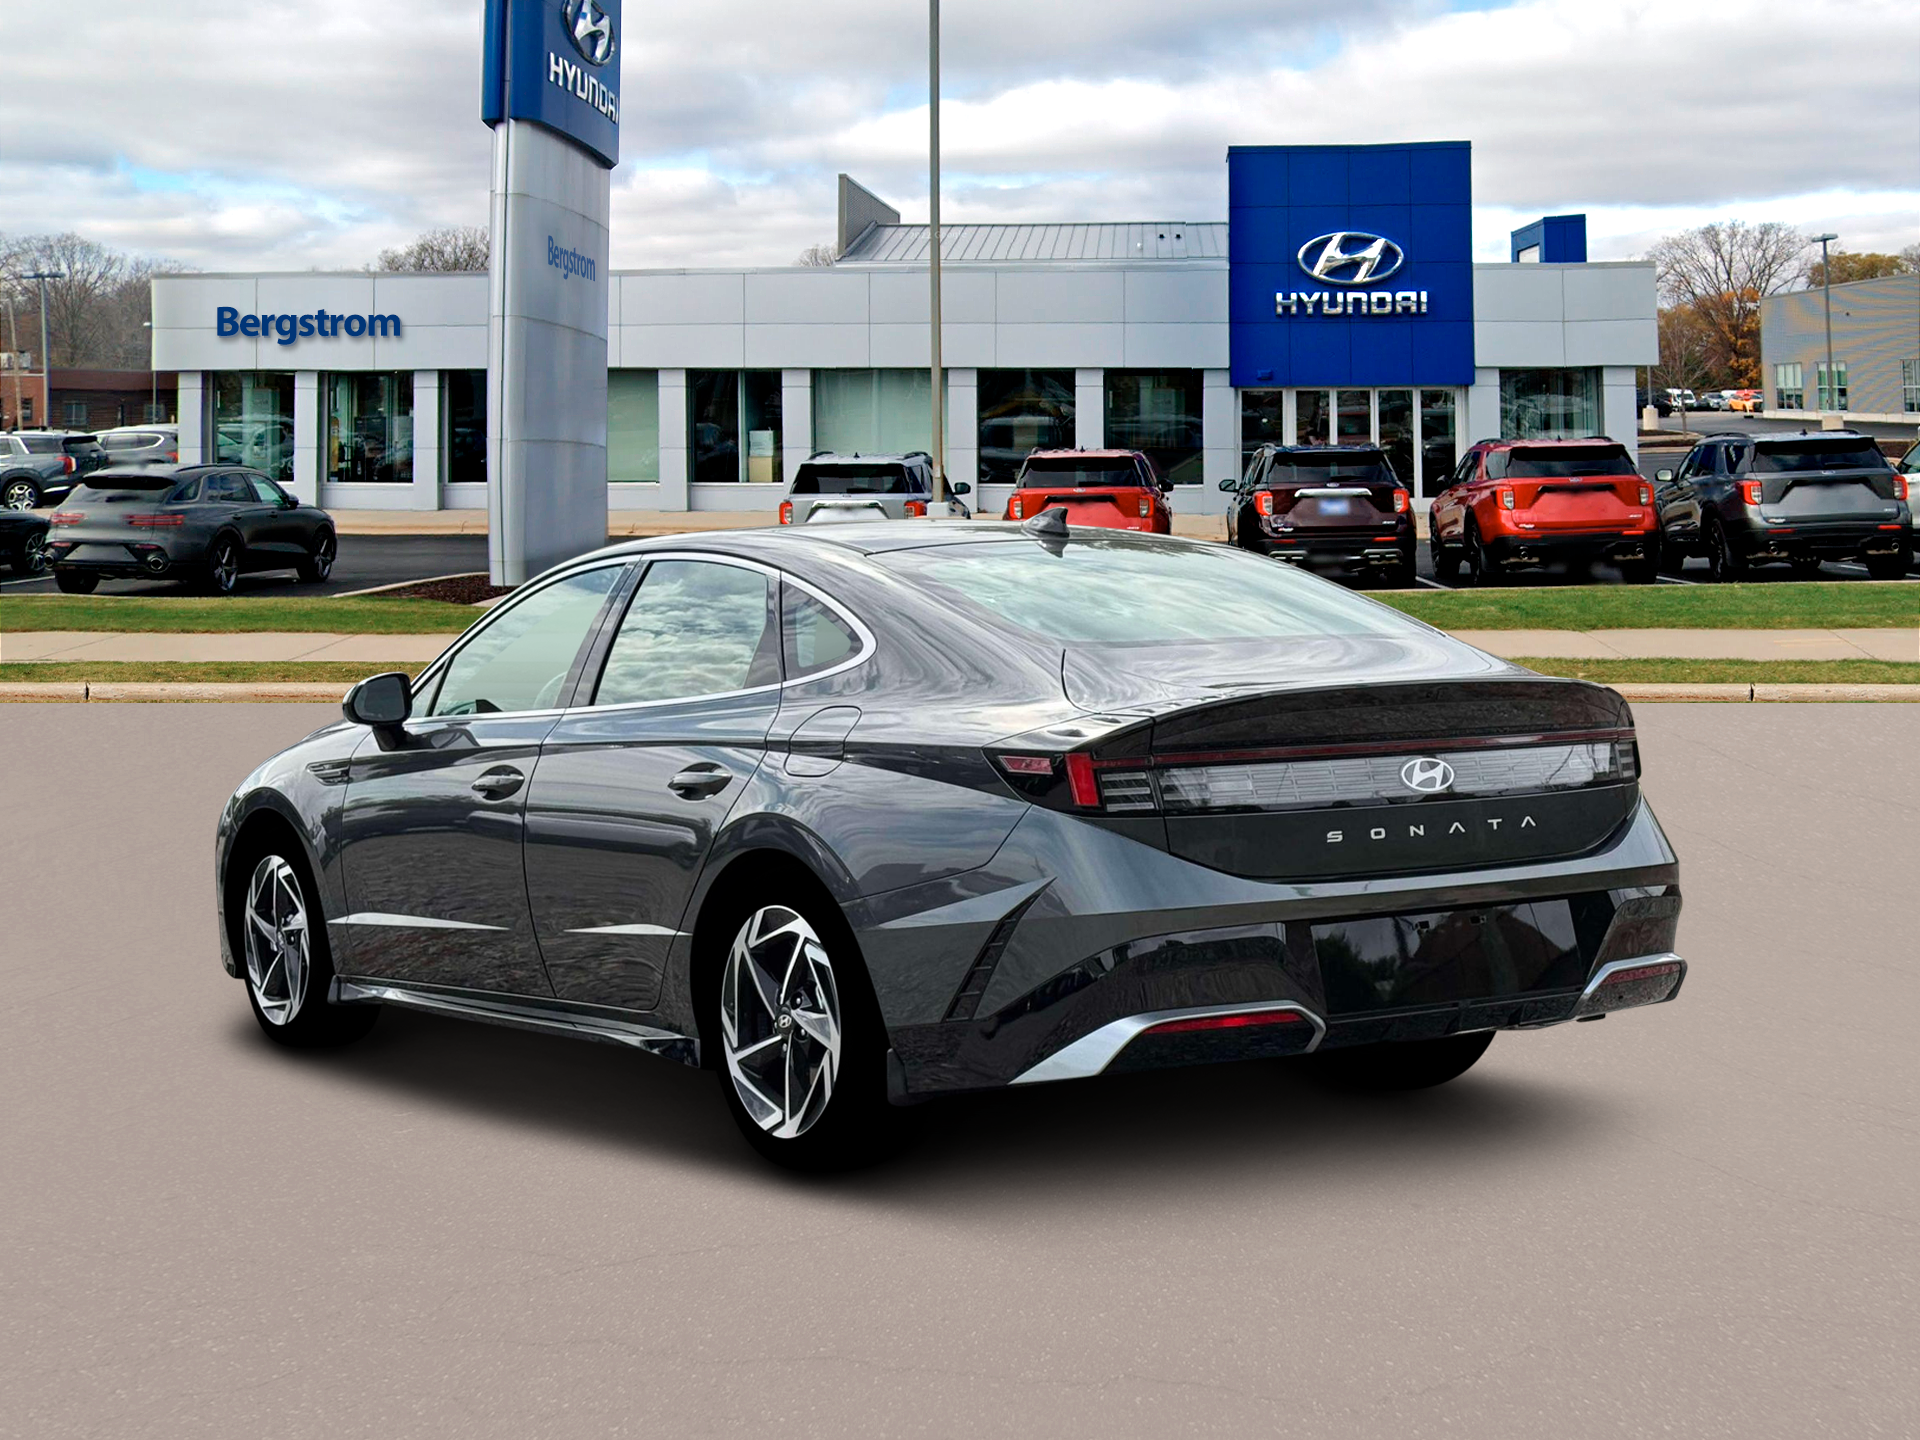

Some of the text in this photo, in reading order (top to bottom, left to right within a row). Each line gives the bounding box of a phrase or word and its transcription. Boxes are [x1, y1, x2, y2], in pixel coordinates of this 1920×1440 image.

[549, 51, 619, 124] HYUNDAI
[547, 234, 596, 282] Bergstrom
[1275, 290, 1428, 315] HYUNDAI
[216, 306, 401, 346] Bergstrom
[1326, 815, 1537, 843] SONATA
